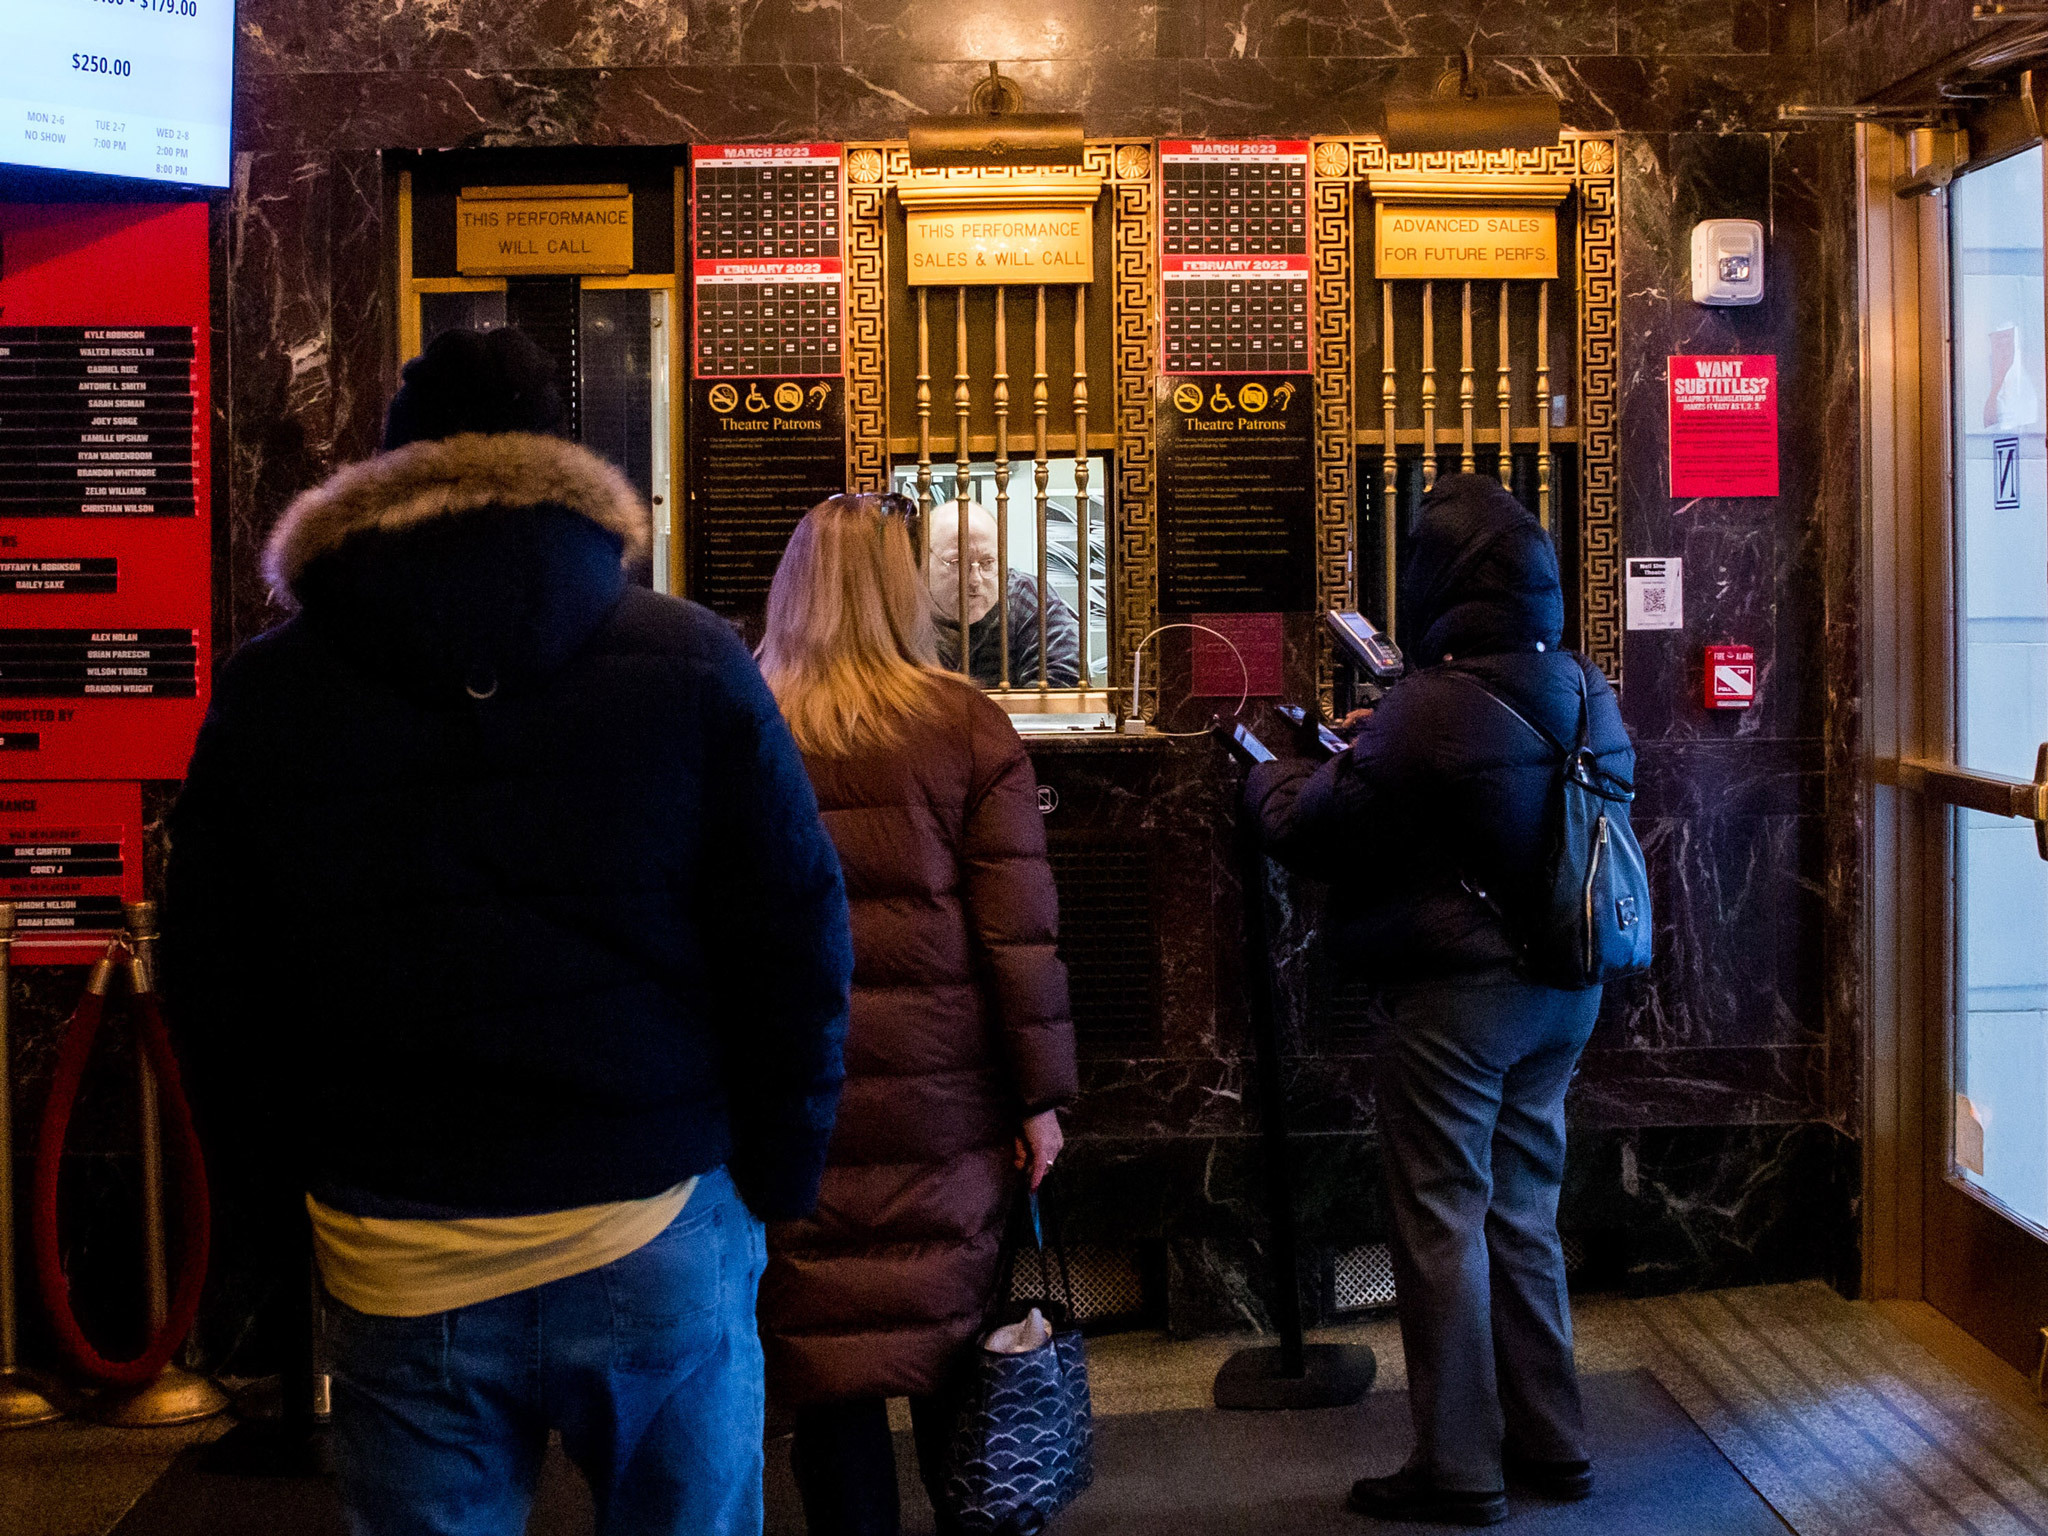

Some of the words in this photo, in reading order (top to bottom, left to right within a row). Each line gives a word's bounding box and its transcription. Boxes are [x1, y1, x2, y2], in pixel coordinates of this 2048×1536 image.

[72, 53, 130, 76] $250.00
[27, 111, 48, 124] MON
[52, 114, 64, 125] 2-6
[96, 120, 110, 131] TUE
[113, 122, 125, 132] 2-7
[25, 130, 37, 140] NO
[40, 131, 66, 144] SHOW
[156, 128, 174, 139] WED
[177, 130, 189, 141] 2-8
[94, 138, 110, 150] 7:00
[114, 140, 126, 151] PM
[1191, 144, 1239, 154] MARCH
[1241, 144, 1276, 153] 2023
[156, 146, 173, 158] 2:00
[176, 148, 188, 158] PM
[724, 148, 773, 158] MARCH
[774, 148, 809, 157] 2023
[156, 164, 172, 174] 8:00
[175, 166, 188, 176] PM
[462, 212, 499, 227] THIS
[506, 210, 628, 226] PERFORMANCE
[918, 224, 954, 238] THIS
[962, 222, 1080, 237] PERFORMANCE
[1392, 219, 1479, 232] ADVANCED
[1487, 219, 1540, 232] SALES
[499, 240, 538, 255] WILL
[547, 239, 590, 254] CALL
[914, 253, 967, 267] SALES
[976, 253, 986, 266] &
[995, 252, 1034, 266] WILL
[1042, 251, 1085, 265] CALL
[1384, 248, 1417, 261] FOR
[1425, 248, 1487, 261] FUTURE
[1495, 248, 1550, 261] PERFS.
[715, 264, 784, 275] FEBRUARY
[786, 264, 821, 274] 2023
[1183, 261, 1251, 271] FEBRUARY
[1252, 260, 1288, 270] 2023
[80, 348, 110, 356] WALTER
[111, 348, 144, 356] RUSSELL
[1696, 361, 1743, 378] WANT
[121, 382, 146, 390] SMITH
[1674, 378, 1770, 394] SUBTITLES?
[88, 400, 114, 408] SARAH
[114, 400, 145, 408] SIGMAN
[91, 417, 112, 425] JOEY
[113, 417, 138, 425] SORGE
[720, 417, 769, 430] Theatre
[773, 417, 821, 430] Patrons
[1185, 418, 1234, 430] Theatre
[1238, 418, 1286, 430] Patrons
[116, 434, 149, 442] UPSHAW
[78, 452, 98, 460] RYAN
[77, 469, 114, 477] BRANDON
[108, 487, 147, 495] WILLIAMS
[81, 504, 123, 512] CHRISTIAN
[124, 504, 154, 512] WILSON
[0, 563, 31, 571] TIFFANY
[41, 563, 80, 571] ROBINSON
[91, 633, 110, 641] ALEX
[1736, 652, 1753, 660] ALARM
[123, 685, 154, 693] WRIGHT
[57, 866, 63, 874] J
[46, 901, 76, 909] NELSON
